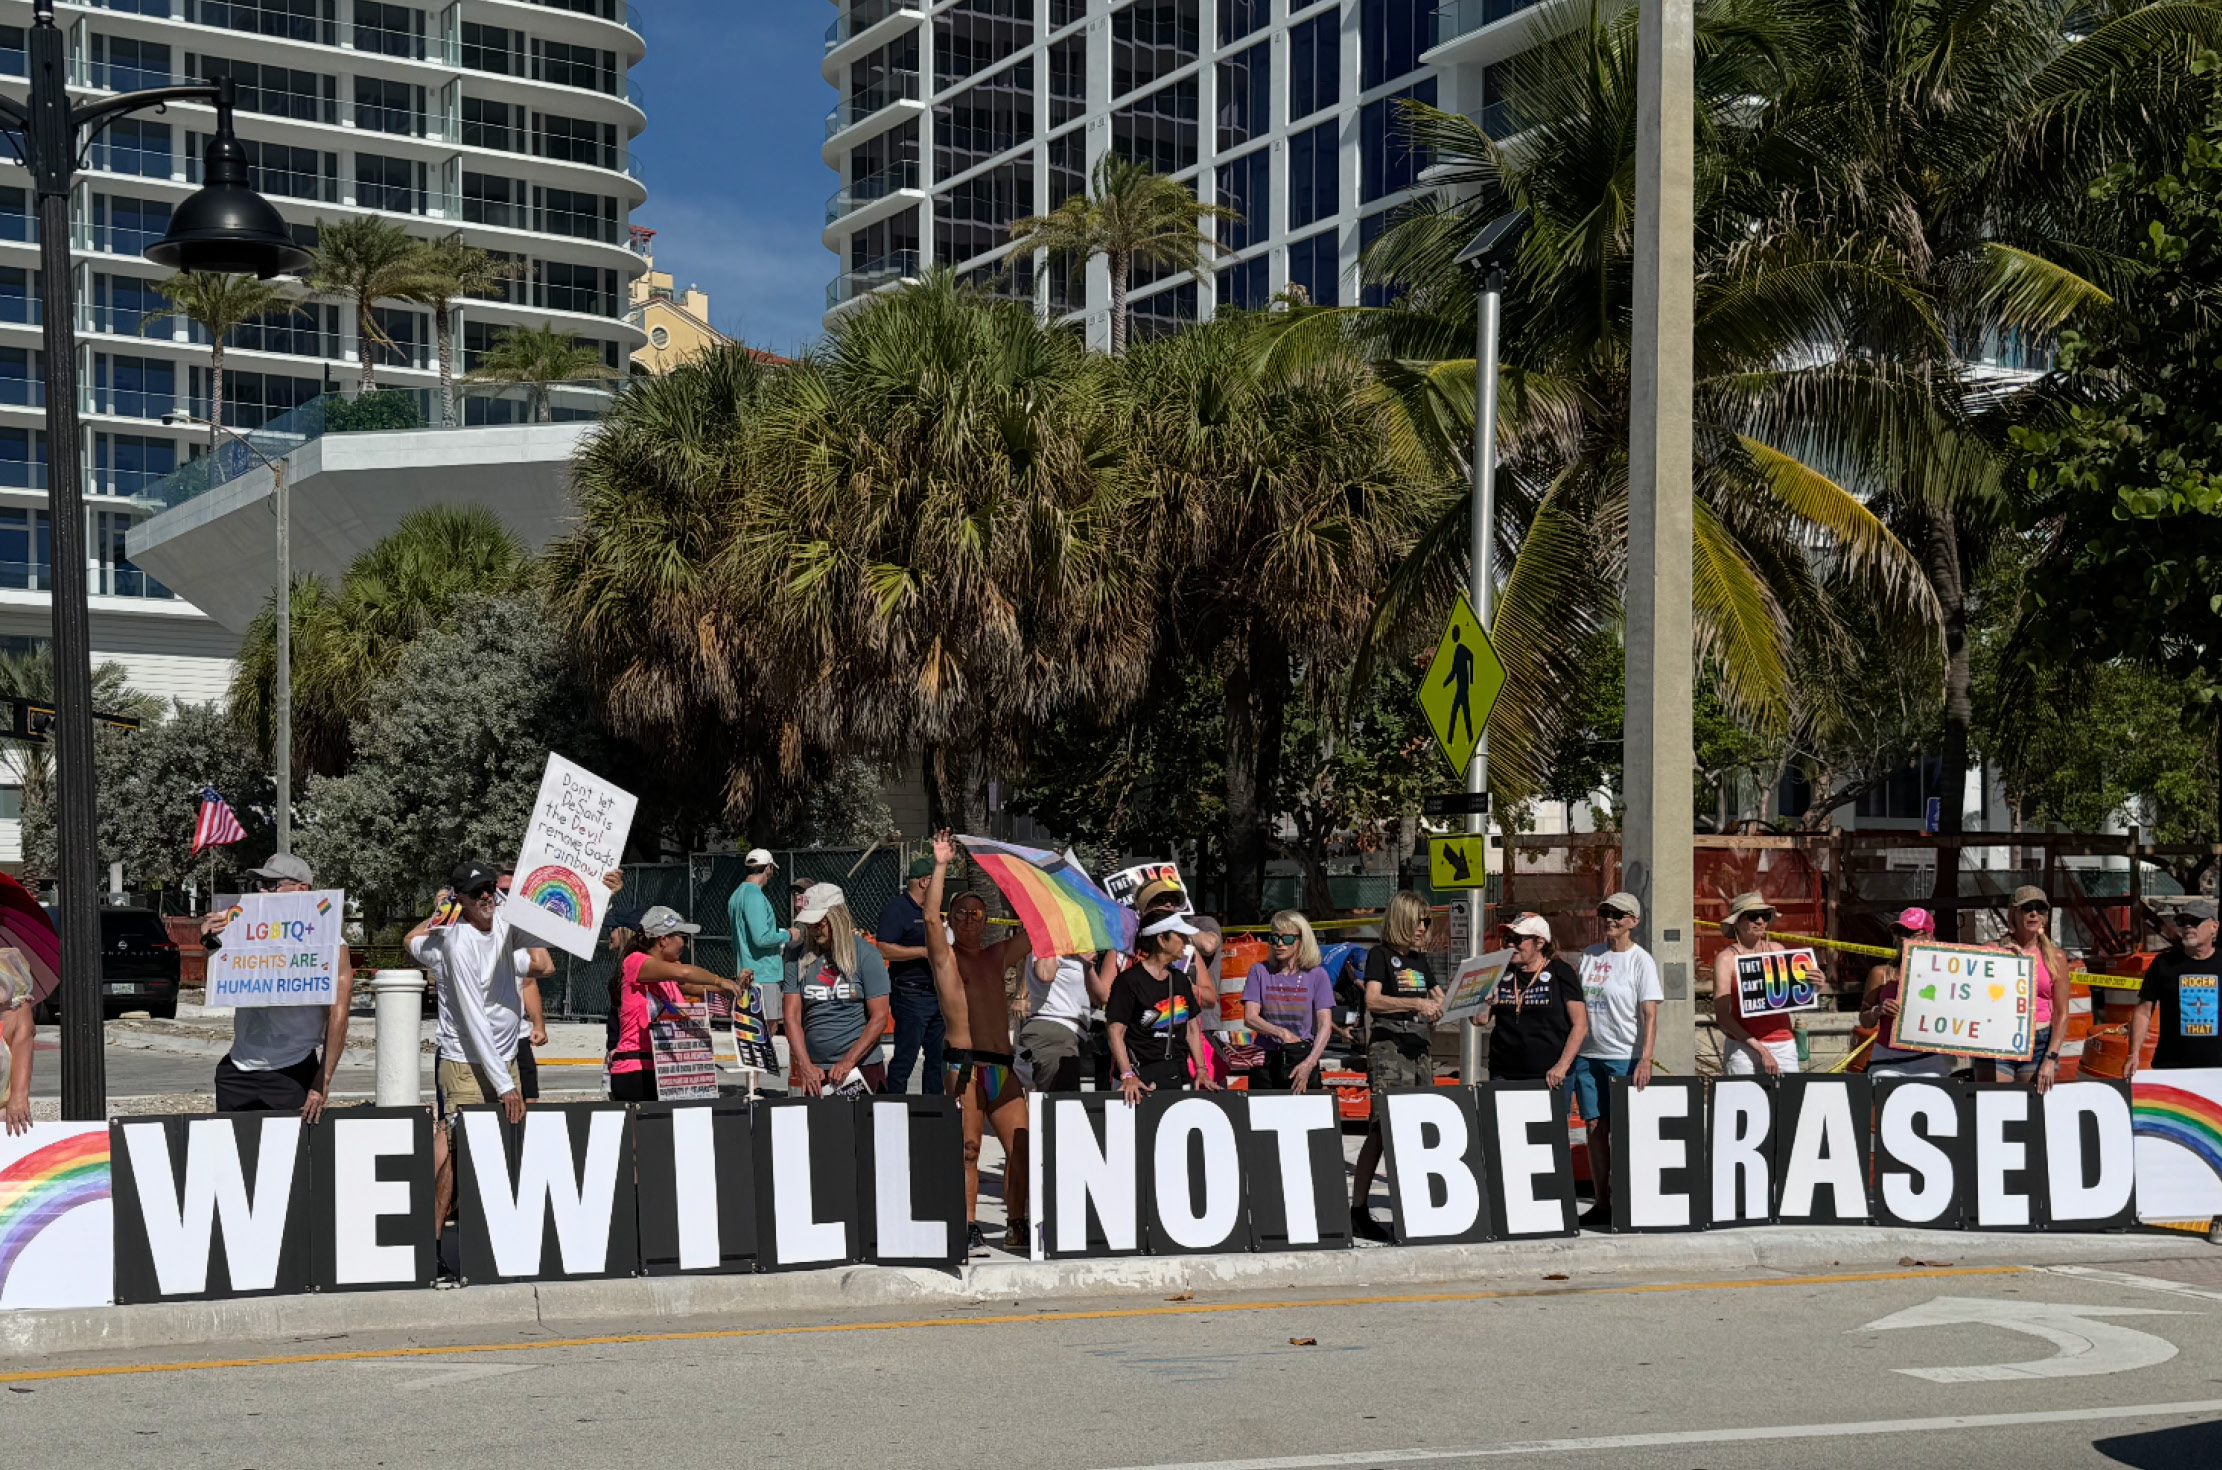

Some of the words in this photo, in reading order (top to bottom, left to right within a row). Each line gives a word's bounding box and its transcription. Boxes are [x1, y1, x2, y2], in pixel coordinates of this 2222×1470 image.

[546, 800, 566, 824] the
[572, 815, 604, 844] Devil
[562, 790, 613, 831] DeSantis
[538, 822, 582, 851] remove
[246, 920, 315, 942] LGBTQ+
[232, 954, 286, 970] RIGHTS
[290, 953, 318, 968] ARE
[1740, 960, 1760, 973] THEY
[1931, 954, 1995, 978] LOVE
[217, 978, 273, 994] HUMAN
[277, 976, 330, 992] RIGHTS
[1762, 953, 1815, 1008] US
[1950, 982, 1971, 1000] IS
[2181, 976, 2216, 988] ROGER
[1744, 997, 1766, 1011] ERASE
[2011, 961, 2028, 1050] LGBTQ
[1918, 1014, 1981, 1039] LOVE
[2186, 1024, 2212, 1035] THAT
[125, 1117, 416, 1296] WE
[462, 1102, 948, 1277] WILL
[1056, 1095, 1334, 1252] NOT
[1392, 1091, 1566, 1239] BE
[1628, 1081, 2135, 1236] ERASED
